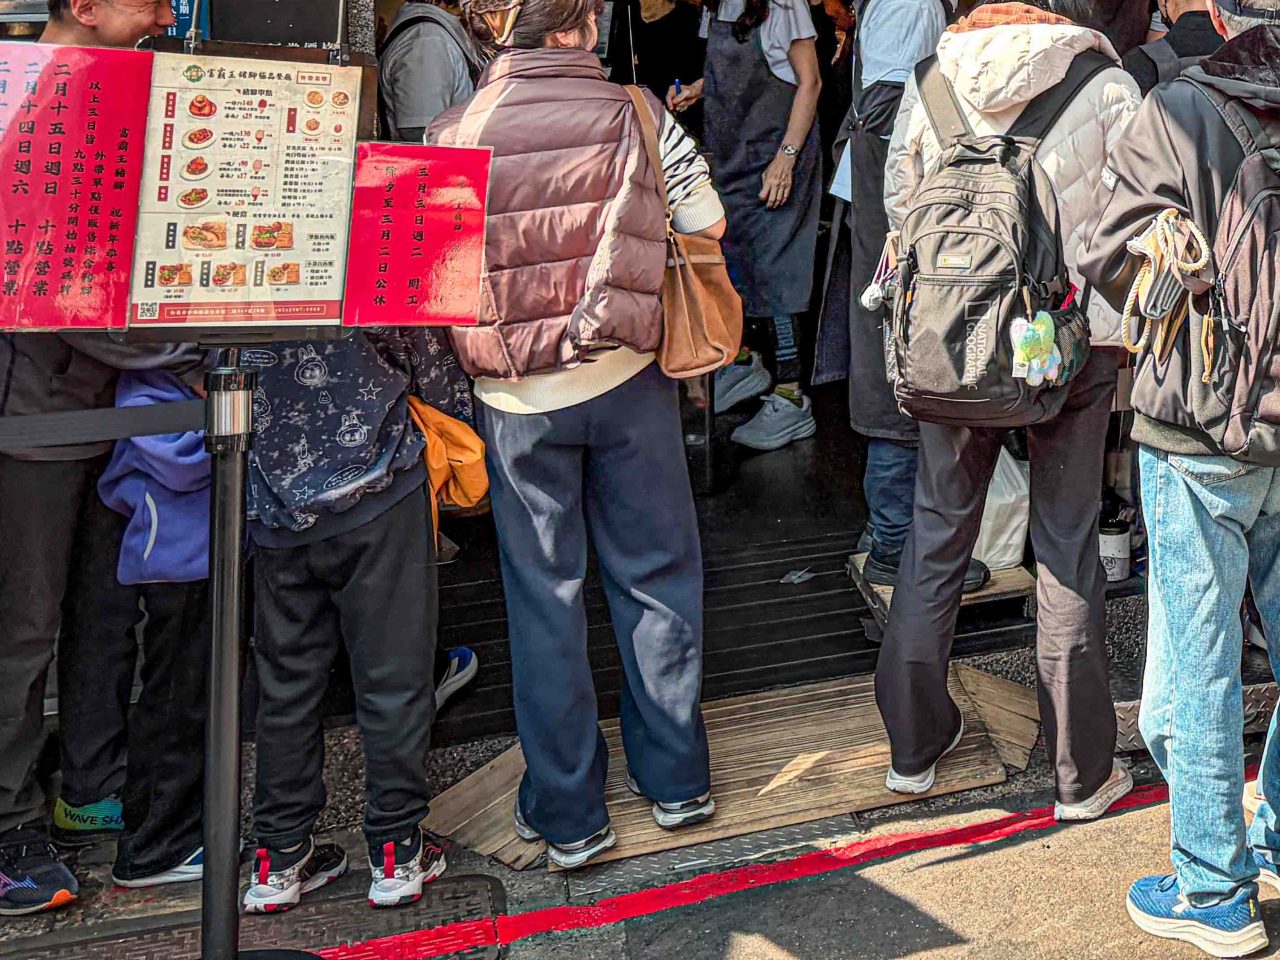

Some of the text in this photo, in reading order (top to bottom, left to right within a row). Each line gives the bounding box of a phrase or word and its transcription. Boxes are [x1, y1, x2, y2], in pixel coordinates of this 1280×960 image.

[43, 63, 72, 196] 二月十五日週日
[410, 167, 430, 257] 三月三日週二
[965, 322, 978, 391] GEOGRAPHIC
[976, 323, 988, 378] NATIONAL
[64, 807, 98, 826] WAVE
